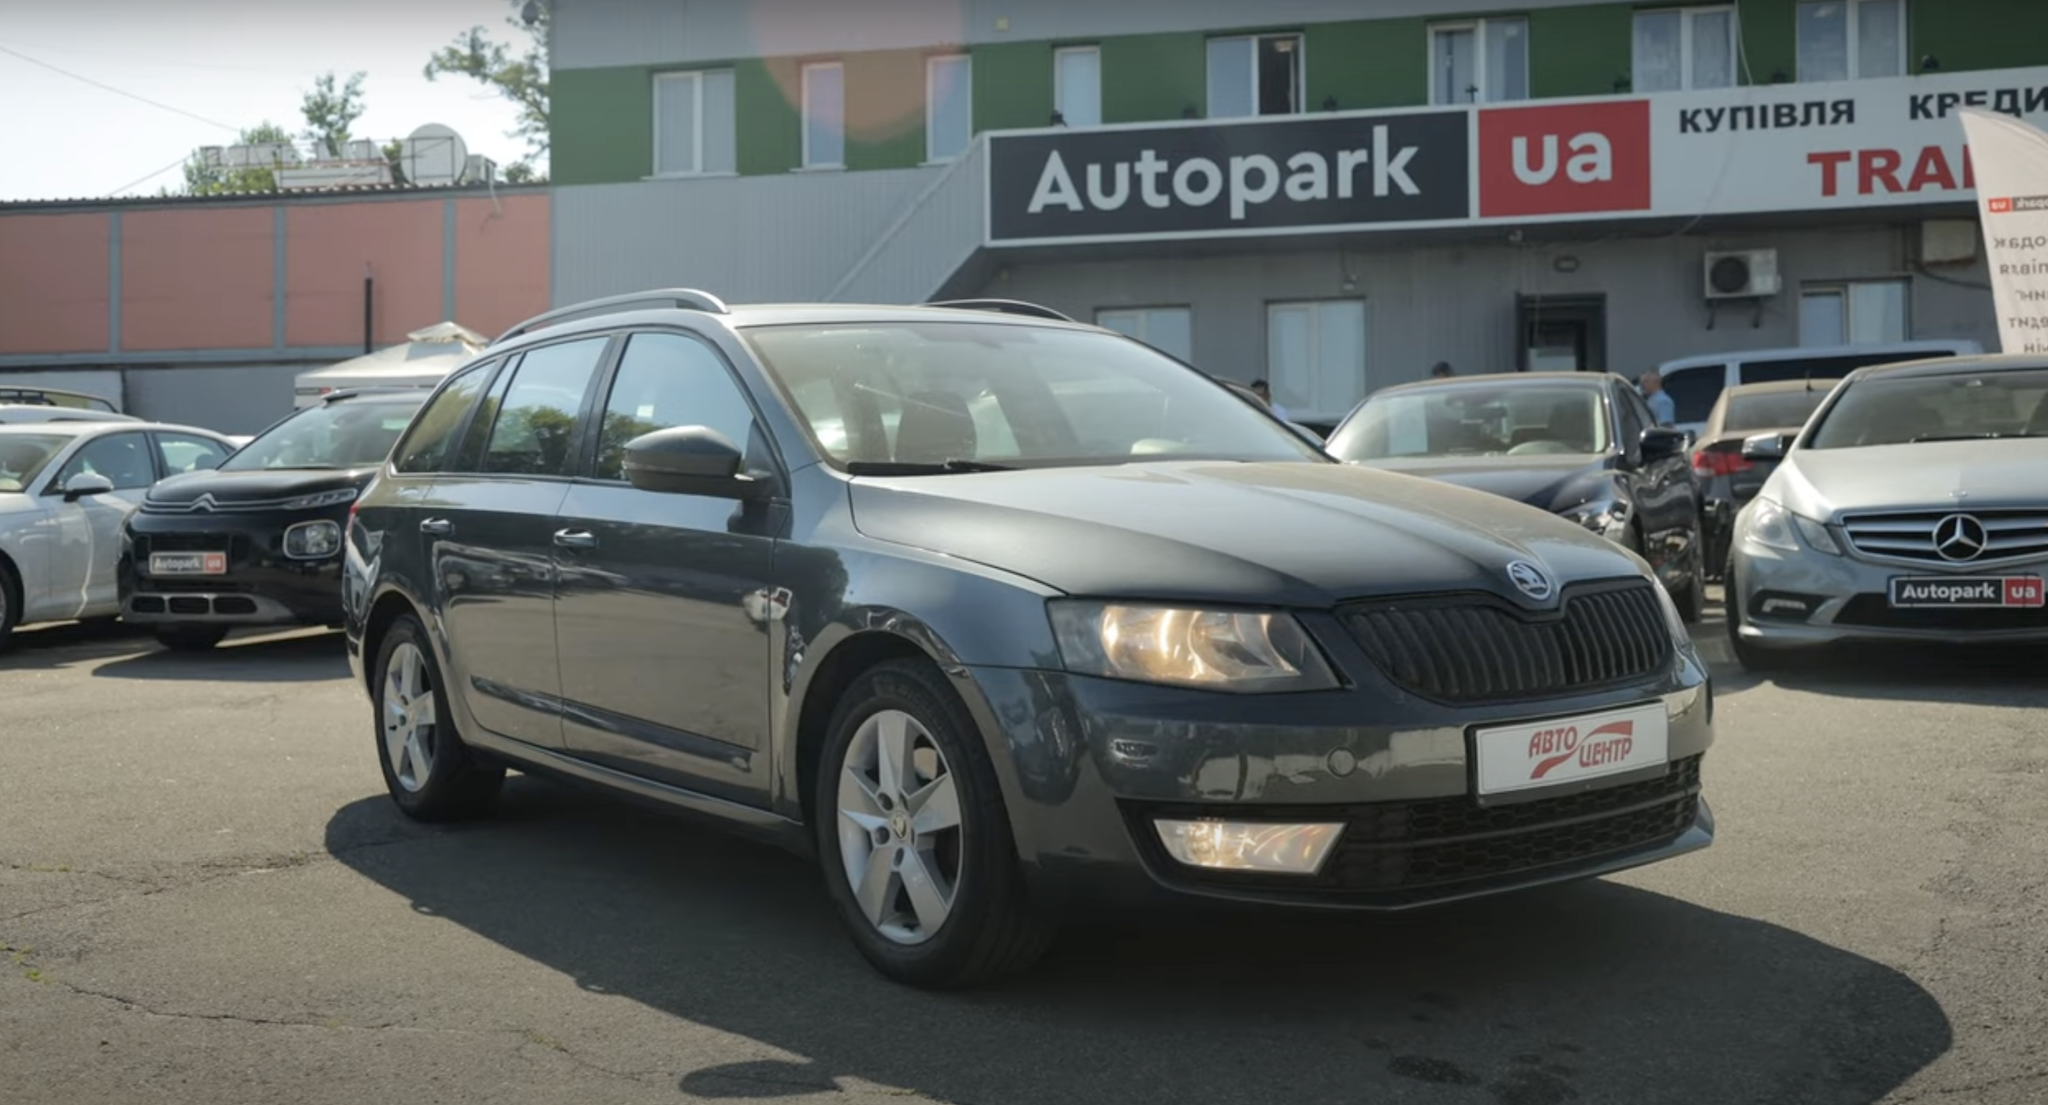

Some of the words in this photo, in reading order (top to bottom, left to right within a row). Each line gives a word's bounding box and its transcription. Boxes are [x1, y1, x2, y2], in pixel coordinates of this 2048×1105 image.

[1679, 98, 1855, 134] КУПІВЛЯ
[1027, 124, 1421, 220] Autopark
[1512, 131, 1613, 185] ua
[154, 556, 201, 571] Autopark
[1902, 582, 1996, 602] Autopark
[2011, 585, 2037, 599] ua
[1528, 725, 1578, 759] АВТО
[1579, 736, 1633, 768] ЦЕНТР
